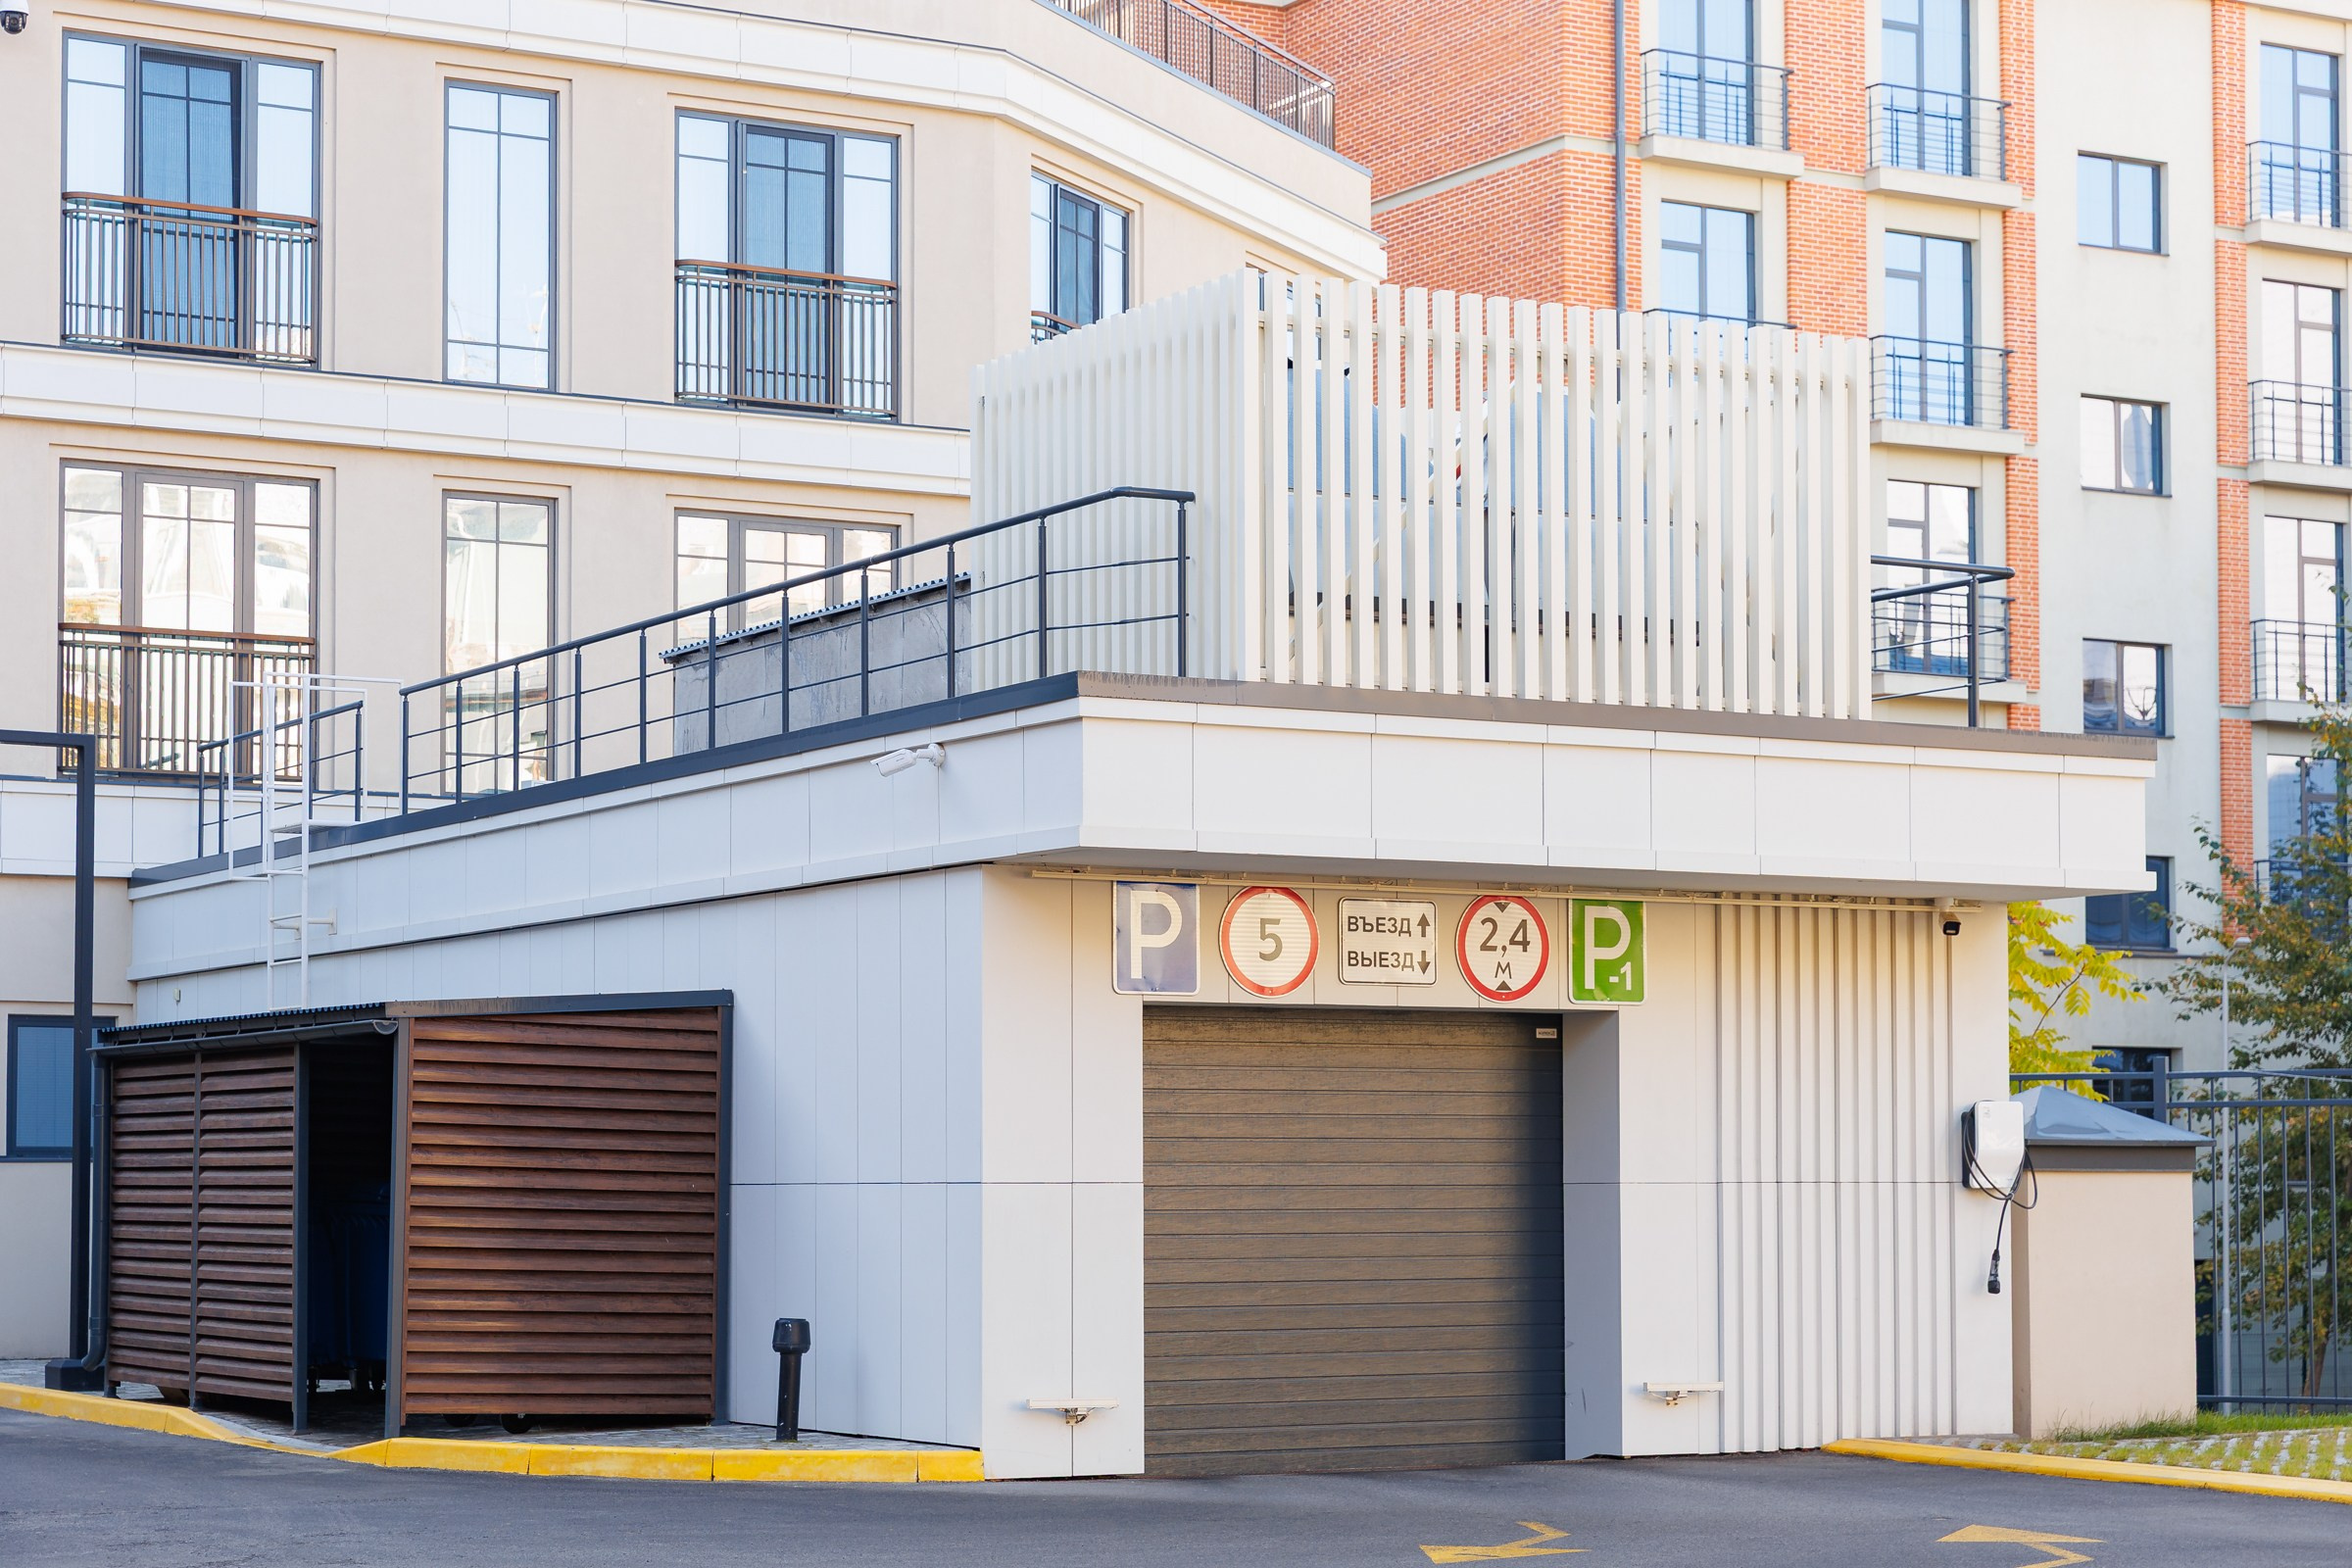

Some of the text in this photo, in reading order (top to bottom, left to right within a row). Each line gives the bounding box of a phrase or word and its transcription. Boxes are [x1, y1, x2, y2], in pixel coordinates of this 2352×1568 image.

[1130, 890, 1182, 979] P
[1258, 917, 1283, 961] 5
[1348, 915, 1411, 937] ВЪЕЗД
[1479, 916, 1531, 957] 2,4
[1348, 951, 1414, 971] ВЫЕЗД
[1584, 905, 1631, 990] P
